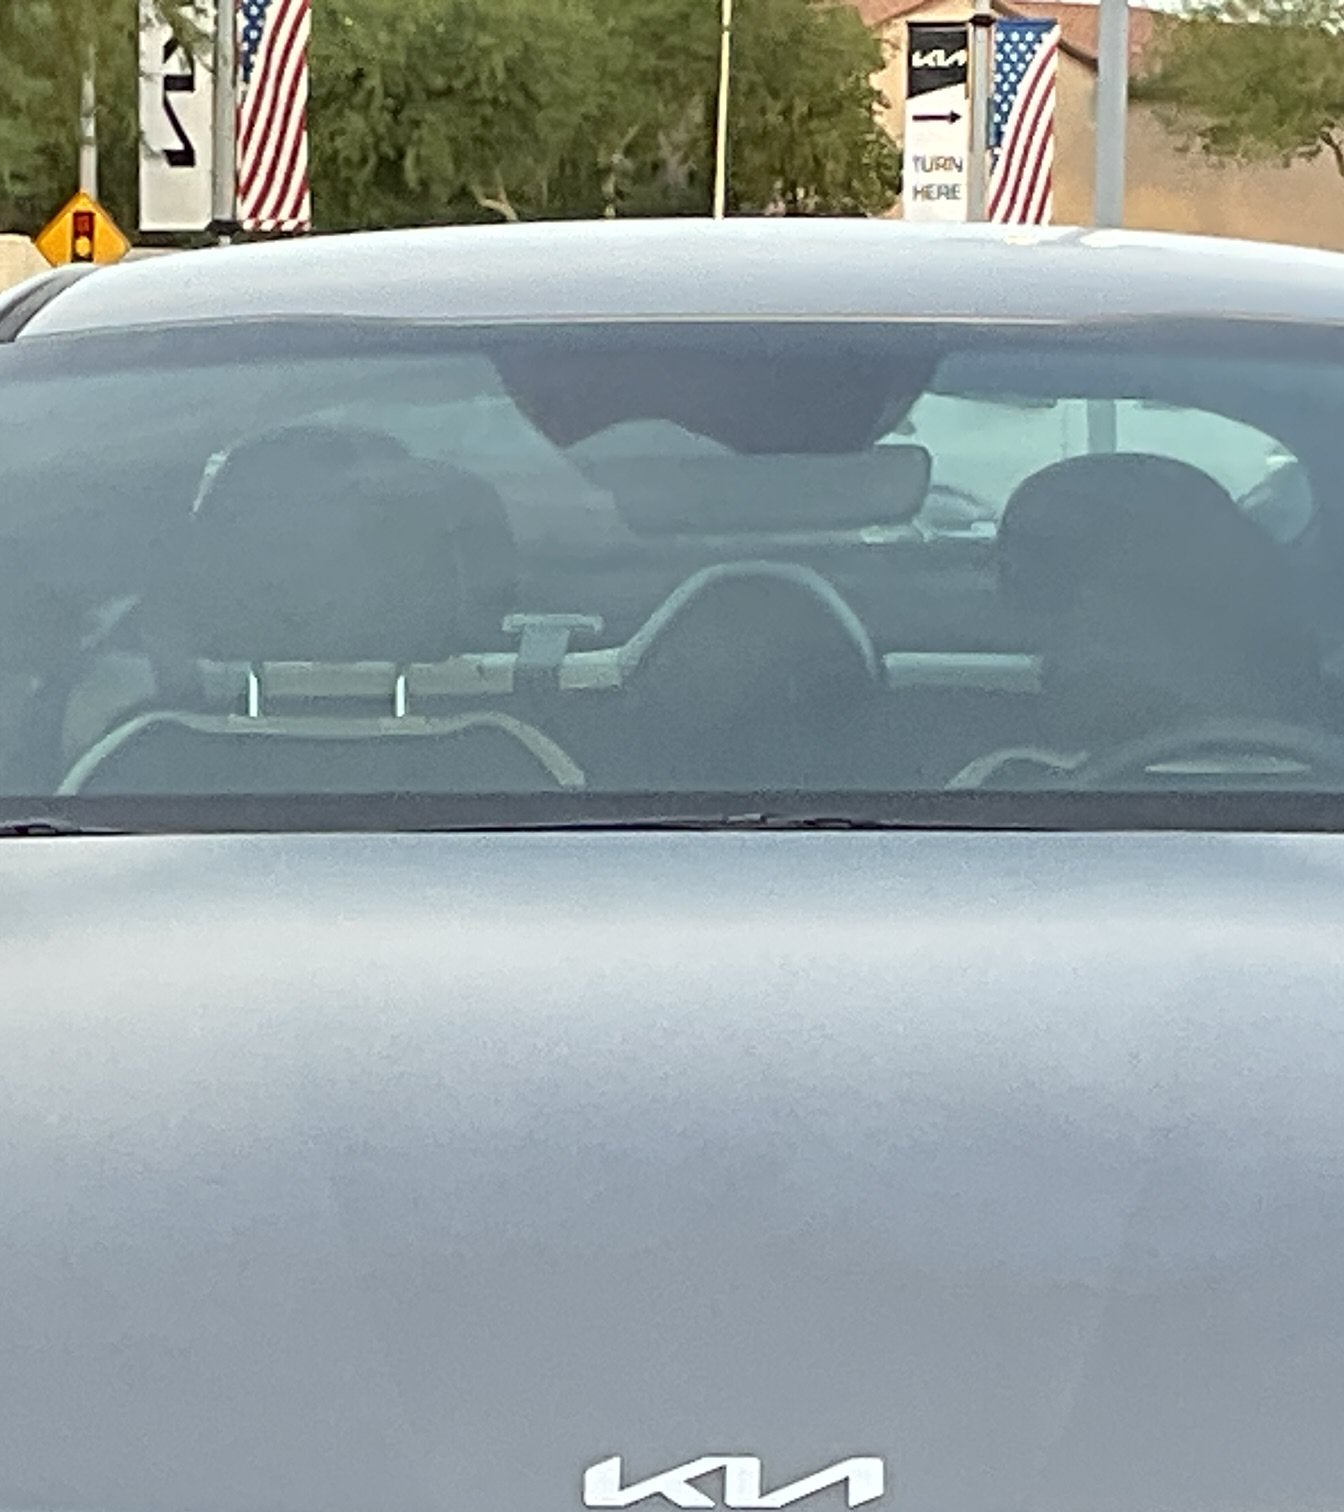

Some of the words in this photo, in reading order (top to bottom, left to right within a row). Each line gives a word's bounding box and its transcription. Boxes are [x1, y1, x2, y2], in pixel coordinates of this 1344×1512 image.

[912, 50, 966, 67] KIA
[912, 156, 963, 173] TURN
[912, 184, 961, 200] HERE
[583, 1454, 886, 1509] KIA
